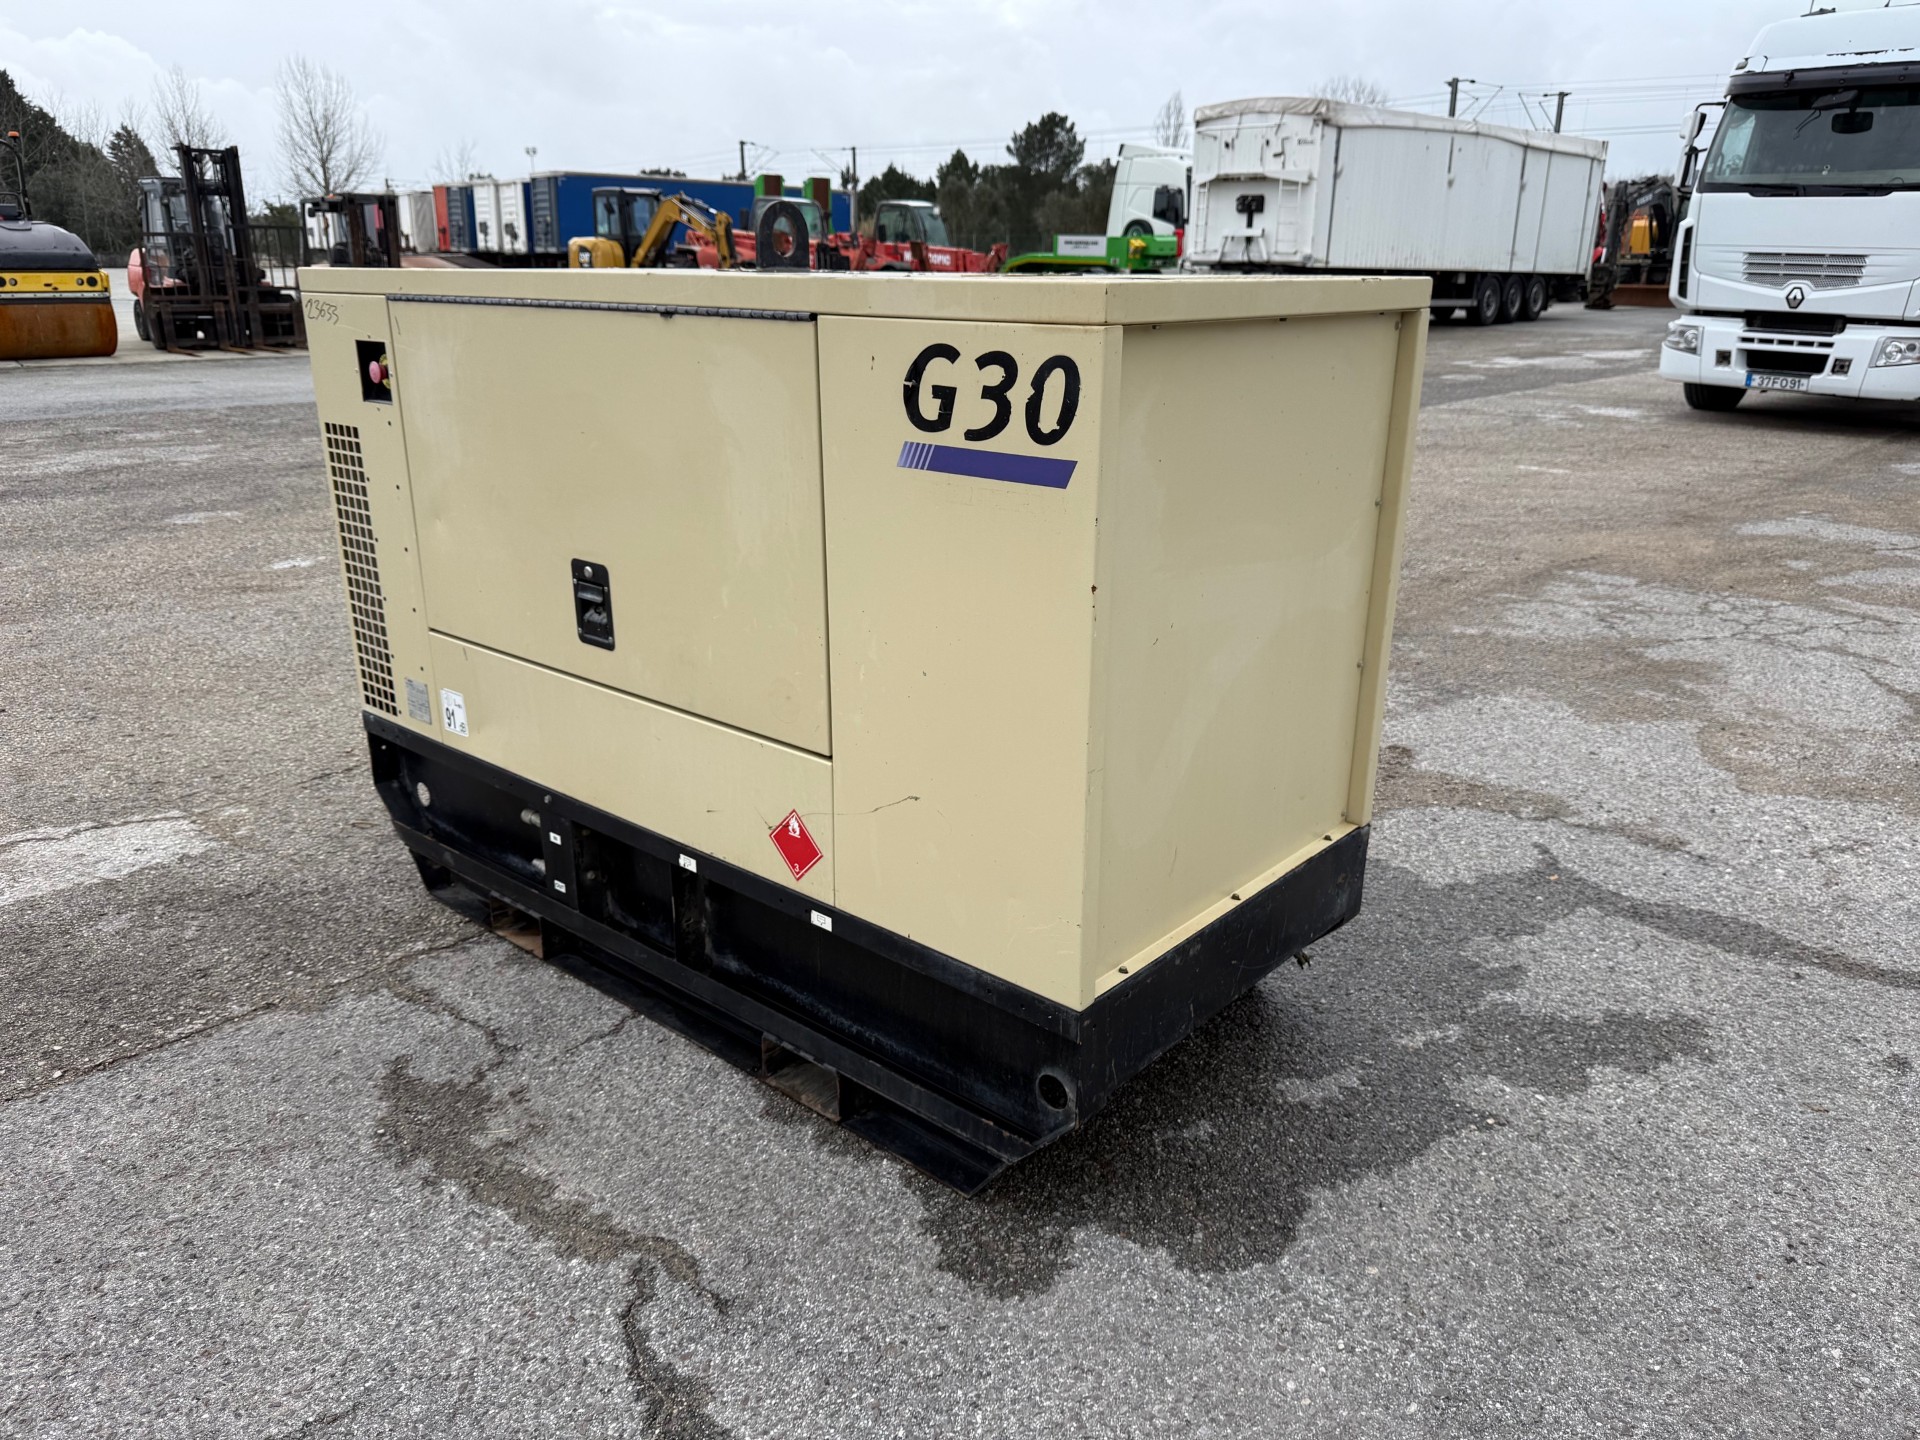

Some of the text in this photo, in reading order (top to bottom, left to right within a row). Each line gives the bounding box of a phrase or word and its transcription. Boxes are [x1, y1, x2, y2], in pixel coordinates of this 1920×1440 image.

[902, 342, 1081, 446] G30
[445, 706, 457, 729] 91
[793, 863, 800, 872] 3
